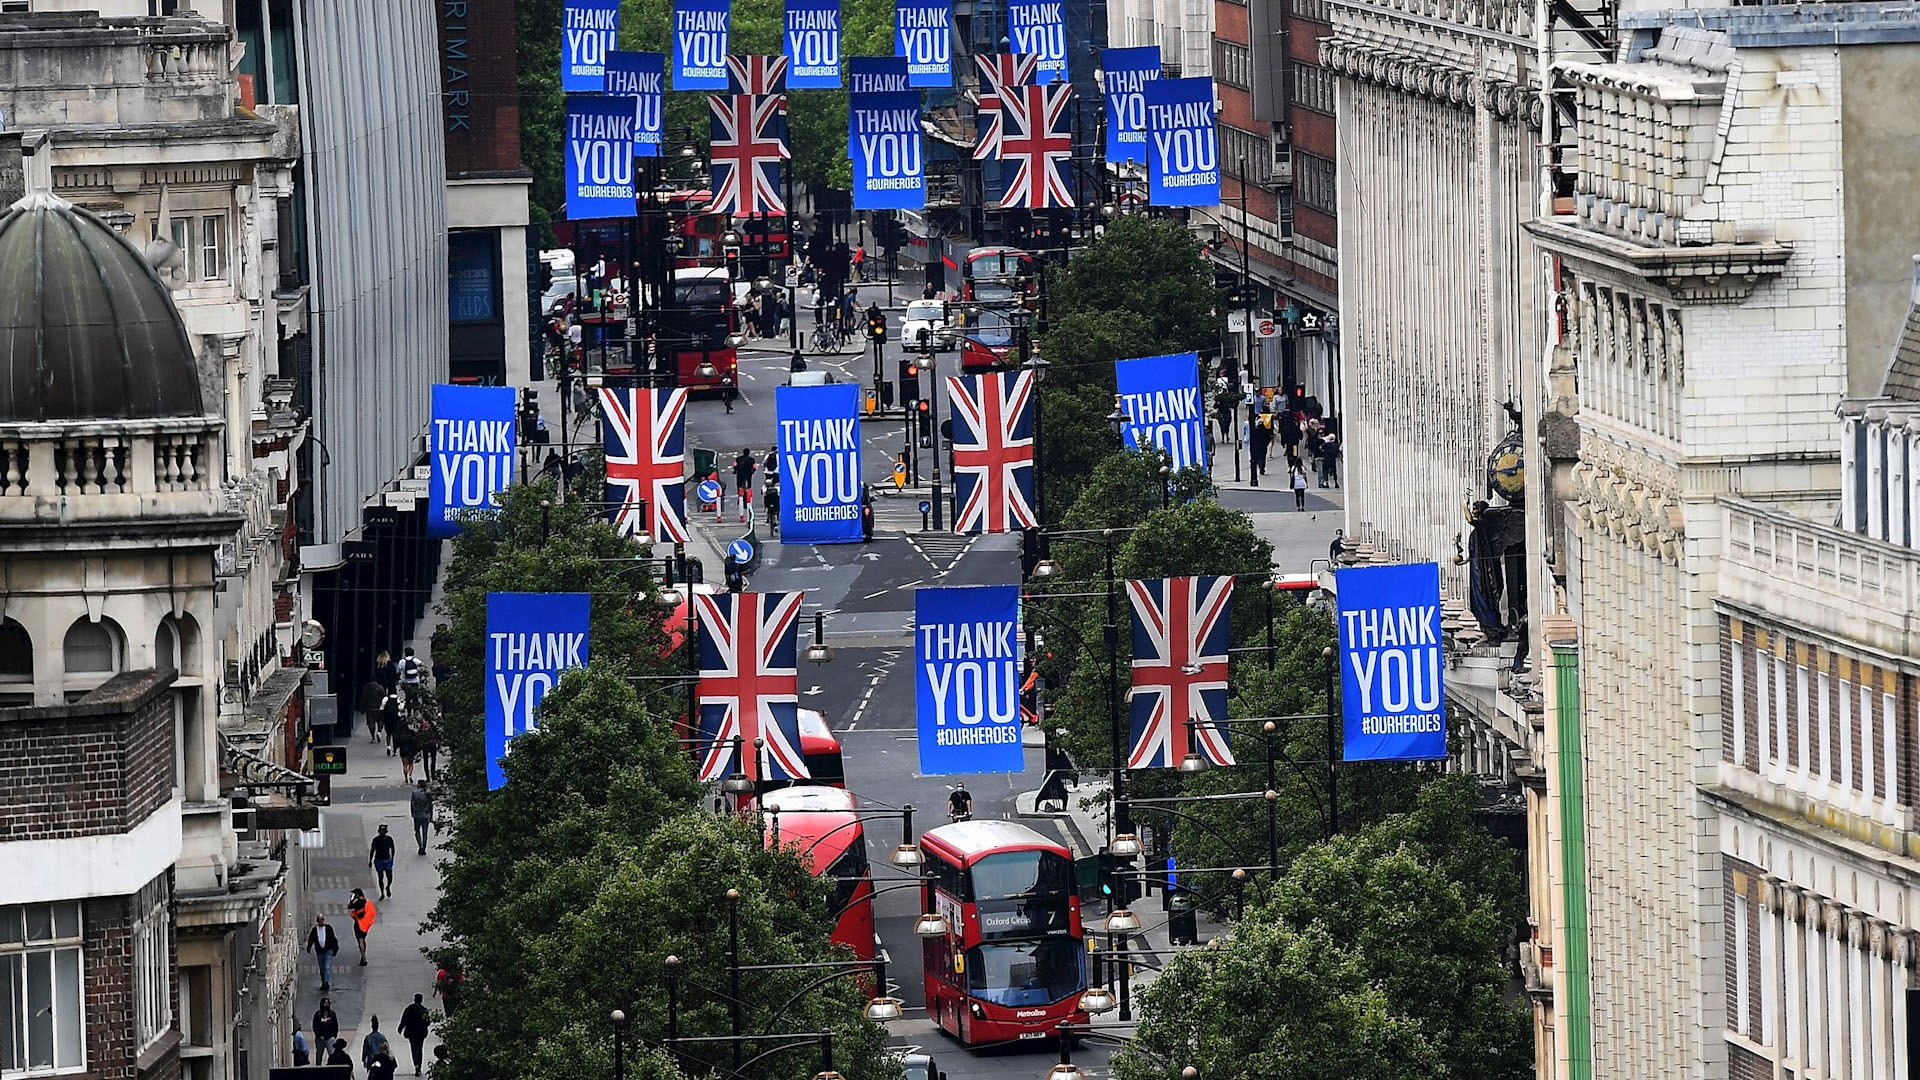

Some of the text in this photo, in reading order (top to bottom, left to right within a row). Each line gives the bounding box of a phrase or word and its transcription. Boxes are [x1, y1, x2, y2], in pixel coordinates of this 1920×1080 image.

[565, 7, 617, 30] THANK
[677, 10, 728, 32] THANK
[786, 9, 838, 30] THANK
[897, 7, 949, 28] THANK
[1009, 2, 1062, 26] THANK
[679, 31, 728, 67] YOU
[788, 30, 838, 66] YOU
[900, 28, 950, 64] YOU
[1014, 24, 1065, 61] YOU
[444, 1, 469, 132] RIMARK
[682, 66, 727, 79] #OURHEROES
[793, 65, 839, 77] #OURHEROES
[606, 70, 662, 94] THANK
[852, 72, 907, 93] THANK
[569, 113, 633, 140] THANK
[855, 108, 919, 133] THANK
[1147, 101, 1213, 131] THANK
[572, 140, 633, 185] YOU
[860, 133, 921, 178] YOU
[1153, 127, 1216, 175] YOU
[577, 184, 633, 199] #OURHEROES
[866, 177, 922, 191] #OURHEROES
[1162, 171, 1217, 189] #OURHEROES
[1122, 386, 1199, 426] THANK
[434, 418, 512, 454] THANK
[780, 417, 856, 453] THANK
[438, 453, 511, 507] YOU
[786, 451, 858, 506] YOU
[794, 504, 859, 522] #OURHEROES
[919, 621, 1014, 661] THANK
[1342, 605, 1438, 650] THANK
[490, 632, 585, 671] THANK
[925, 660, 1016, 726] YOU
[1349, 647, 1440, 714] YOU
[936, 725, 1018, 747] #OURHEROES
[1361, 713, 1441, 735] #OURHEROES
[986, 916, 1031, 926] Oxford Circus
[1047, 910, 1057, 925] 7
